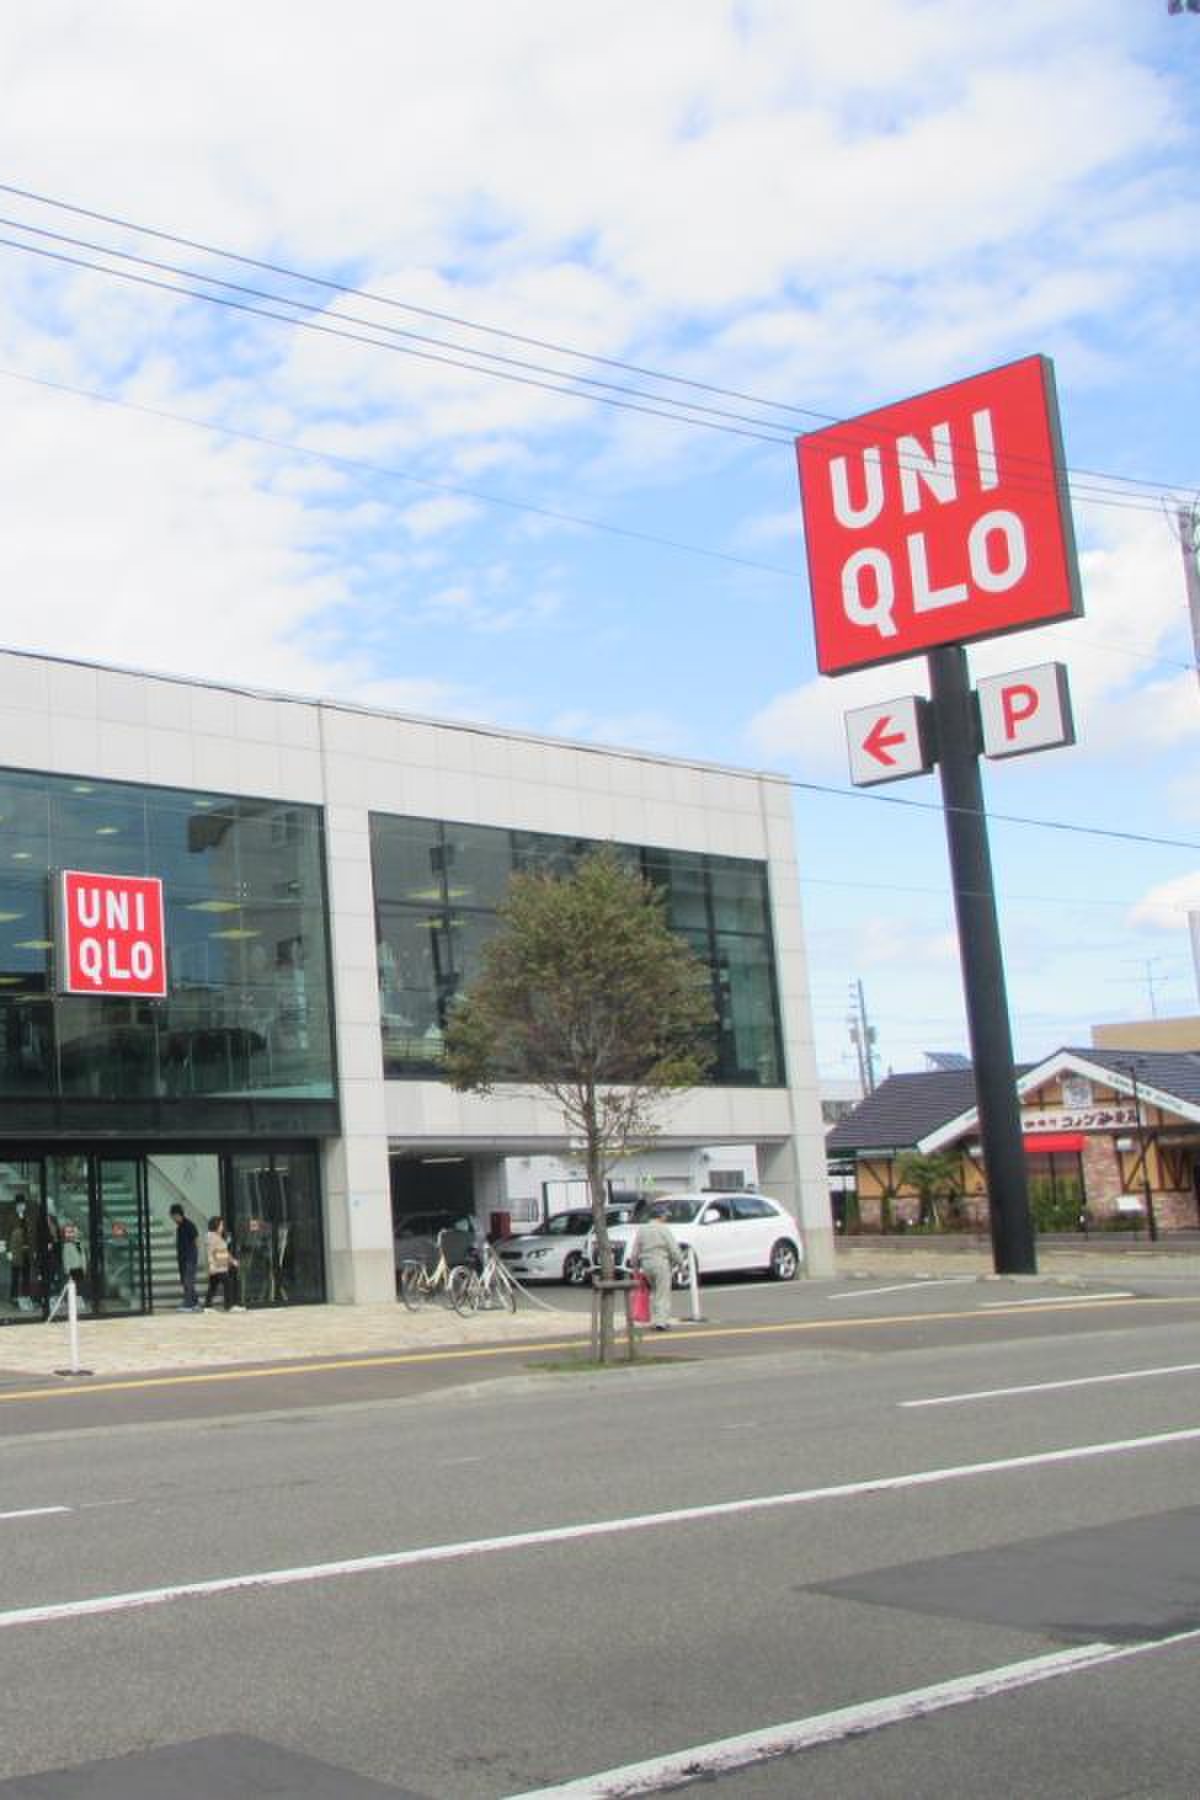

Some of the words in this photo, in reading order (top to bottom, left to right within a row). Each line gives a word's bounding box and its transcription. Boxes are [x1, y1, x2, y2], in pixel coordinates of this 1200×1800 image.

[829, 408, 999, 529] UNI
[841, 509, 1028, 639] QLO
[1001, 683, 1039, 740] P
[77, 887, 145, 932] UNI
[79, 937, 153, 985] QLO
